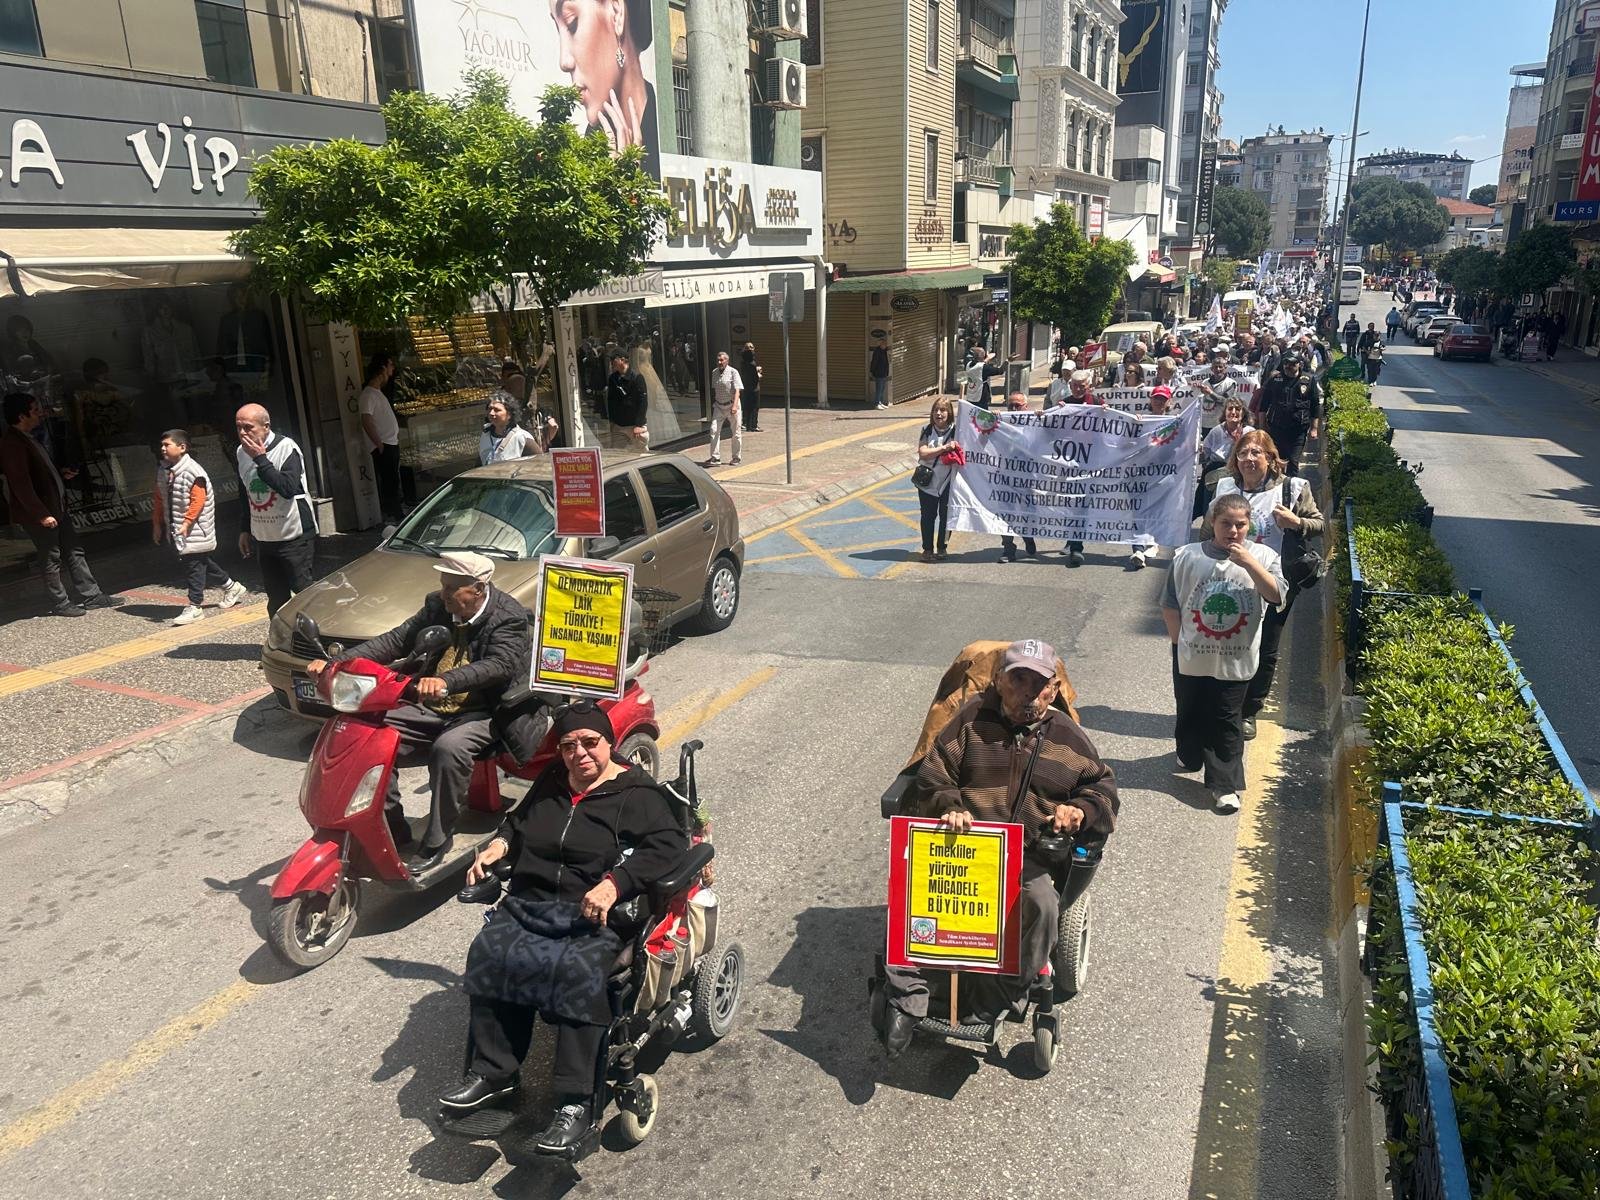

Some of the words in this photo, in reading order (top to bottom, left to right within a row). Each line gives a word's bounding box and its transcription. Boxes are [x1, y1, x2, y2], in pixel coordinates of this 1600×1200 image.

[458, 25, 537, 70] YAĞMUR
[0, 118, 64, 184] A
[1561, 206, 1593, 216] KURS
[827, 219, 857, 243] YA
[709, 280, 741, 294] MODA
[748, 279, 754, 291] &
[1523, 294, 1532, 305] D
[1097, 390, 1153, 400] KURTULU
[340, 350, 372, 482] YAĞR
[1009, 414, 1072, 434] SEFALET
[1073, 413, 1143, 442] ZÜLMÜNE
[1051, 438, 1092, 467] SON
[964, 451, 1002, 471] EMEKLİ
[1003, 455, 1057, 477] YÜRÜYOR
[1058, 464, 1120, 480] MÜCADELE
[1121, 461, 1177, 480] SÜRÜYOR
[987, 471, 1009, 486] TÜM
[1012, 476, 1086, 495] EMEKLİLERİN
[990, 489, 1024, 504] AYDIN
[1074, 494, 1142, 512] PLATFORMU
[93, 502, 134, 525] BEDEN
[992, 512, 1029, 524] AYDIN
[1038, 514, 1086, 529] DENİZLİ
[1095, 517, 1140, 532] MUĞLA
[1006, 524, 1029, 536] EGE
[1030, 525, 1069, 540] BÖLGE
[1071, 528, 1122, 543] MİTİNGİ
[557, 576, 613, 597] DEMOKRATİK
[573, 594, 593, 611] LAİK
[549, 624, 583, 643] İNSANCA
[929, 842, 977, 861] Emekliler
[928, 861, 969, 879] yürüyor
[928, 877, 979, 898] MÜCADELE
[927, 895, 989, 917] BÜYÜYOR!
